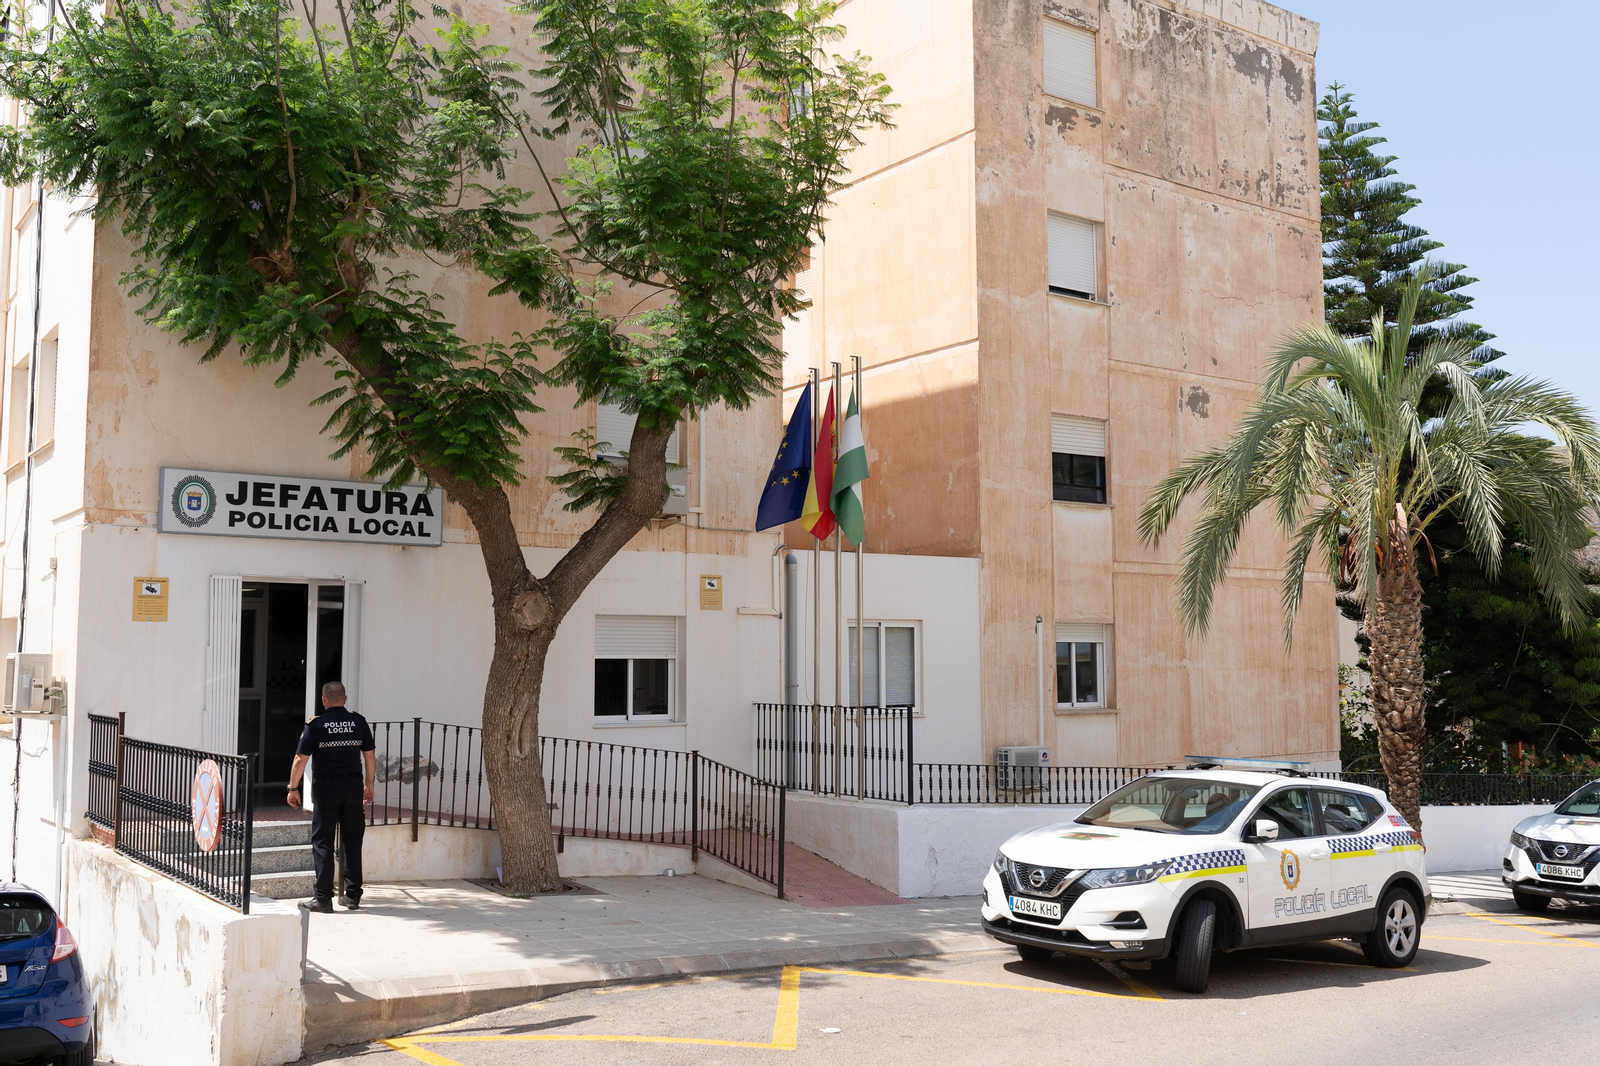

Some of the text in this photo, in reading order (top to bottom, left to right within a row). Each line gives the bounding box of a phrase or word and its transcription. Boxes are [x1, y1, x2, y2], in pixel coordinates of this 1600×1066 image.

[225, 480, 434, 517] JEFATURA
[228, 510, 431, 538] POLICIA LOCAL
[1541, 865, 1582, 877] 4086 KHC
[1015, 899, 1058, 917] 4084 KHC
[1330, 884, 1373, 910] LOCAL
